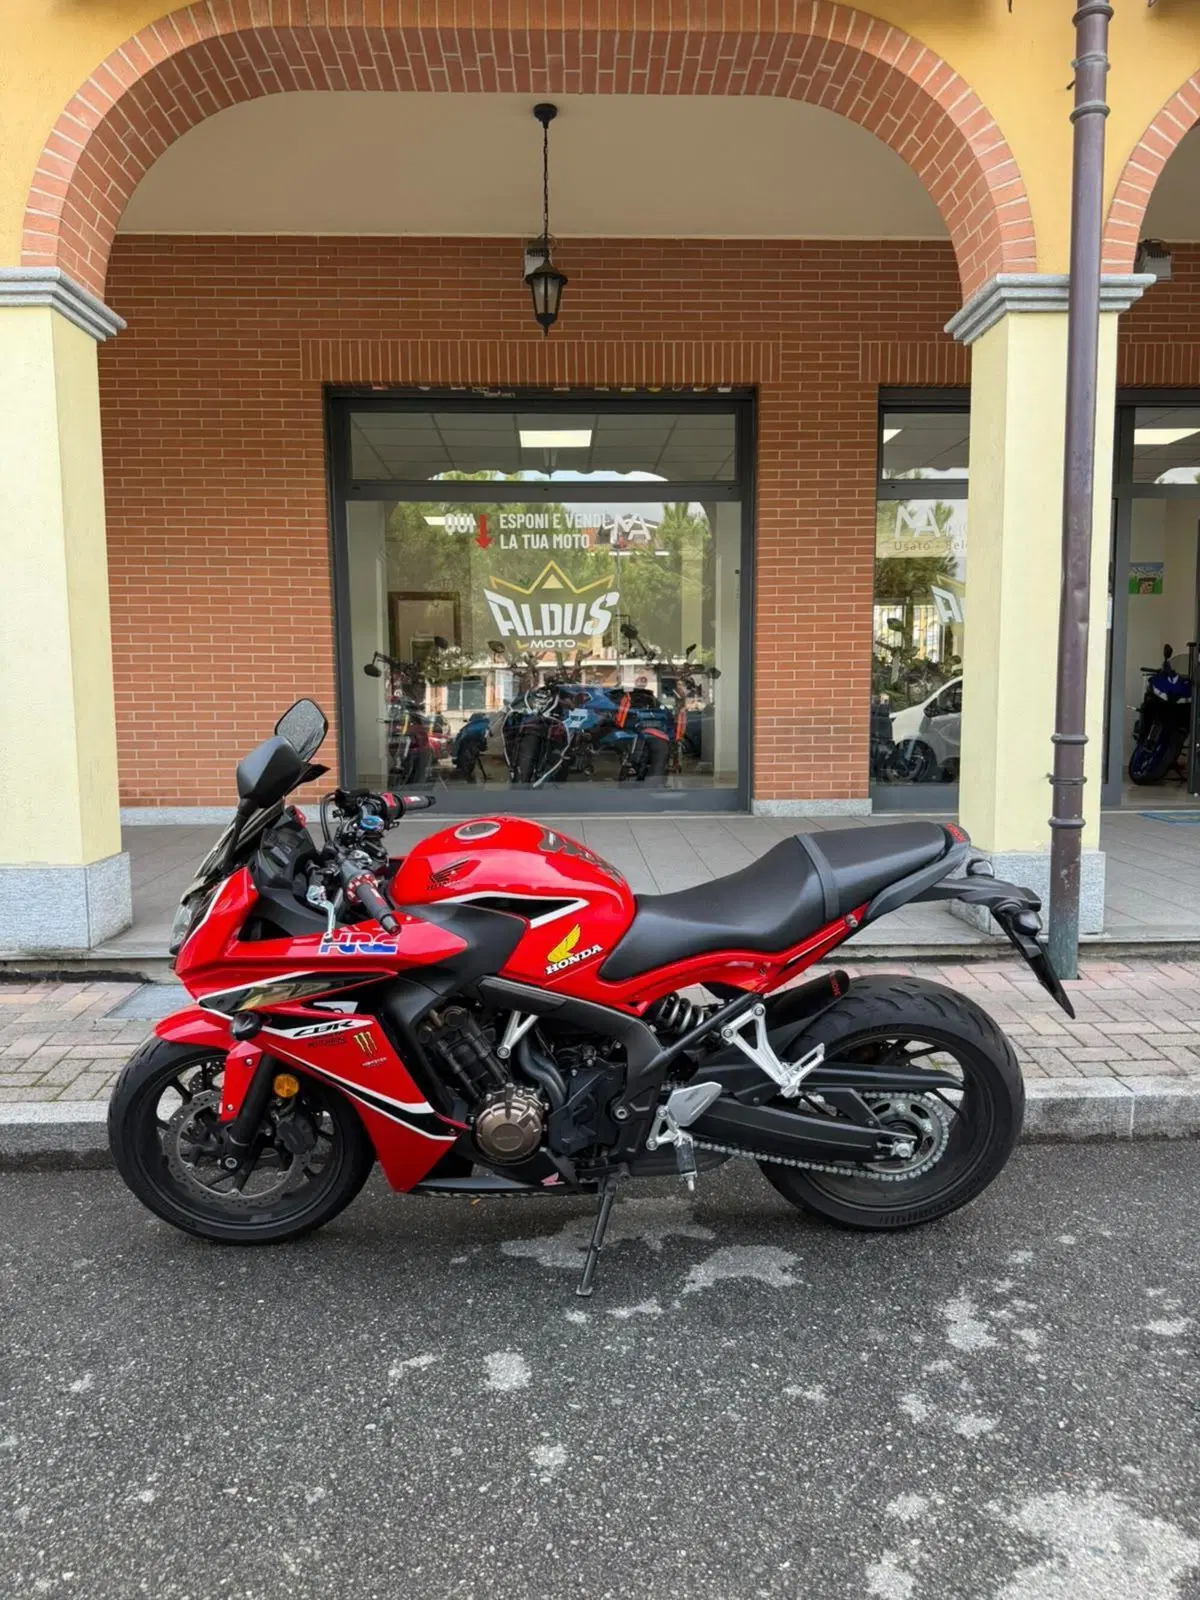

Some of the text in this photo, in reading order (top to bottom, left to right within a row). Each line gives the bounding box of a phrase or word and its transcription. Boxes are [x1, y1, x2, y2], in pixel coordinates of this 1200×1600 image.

[445, 513, 475, 535] QUI
[500, 513, 608, 529] ESPONI E VENDI
[500, 534, 590, 549] LA TUA MOTO
[894, 541, 930, 551] Usato
[483, 588, 620, 637] ALDUS
[530, 639, 576, 649] MOTO
[319, 932, 399, 955] HRC
[545, 944, 604, 975] HONDA
[293, 1020, 354, 1037] CBR
